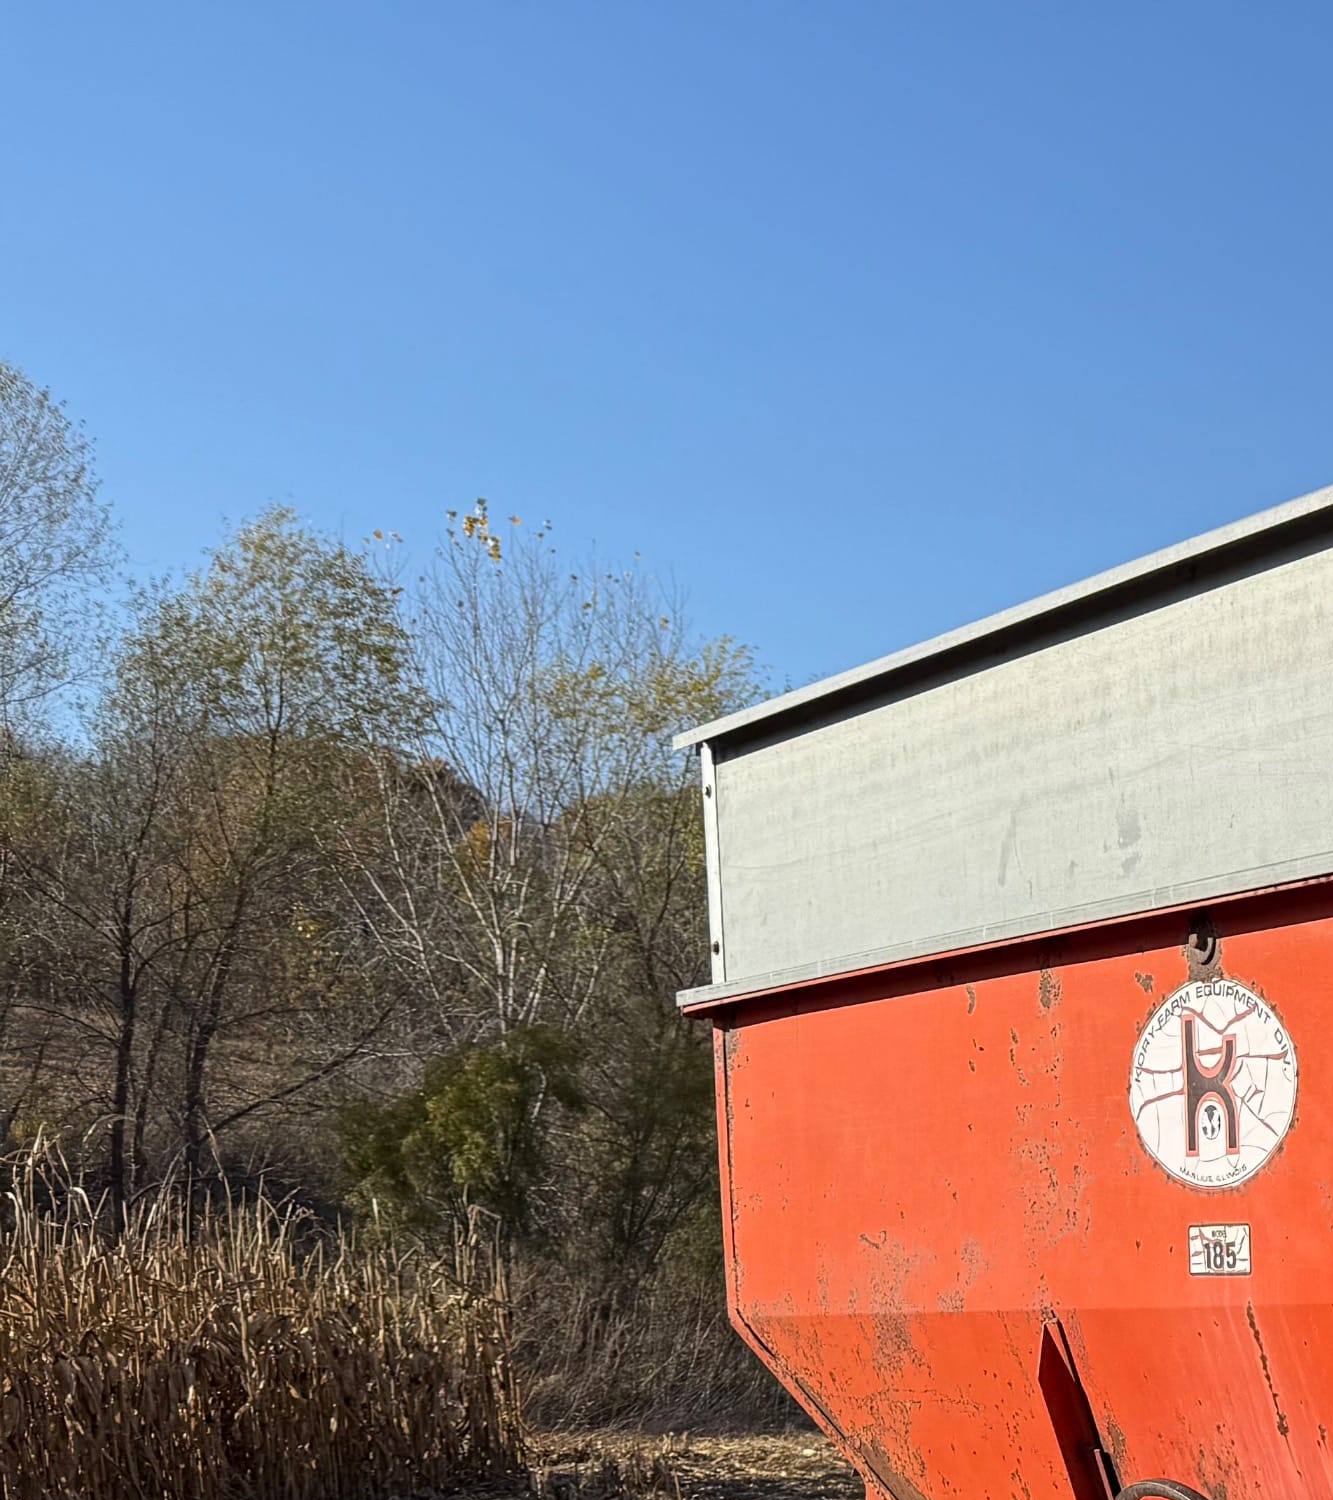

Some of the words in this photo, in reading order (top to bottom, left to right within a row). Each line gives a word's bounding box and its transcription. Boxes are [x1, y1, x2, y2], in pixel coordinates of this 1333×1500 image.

[1134, 1026, 1156, 1083] KORY
[1157, 991, 1191, 1026] FARM
[1195, 983, 1271, 1024] EQUIPMENT
[1204, 1241, 1236, 1269] 185
